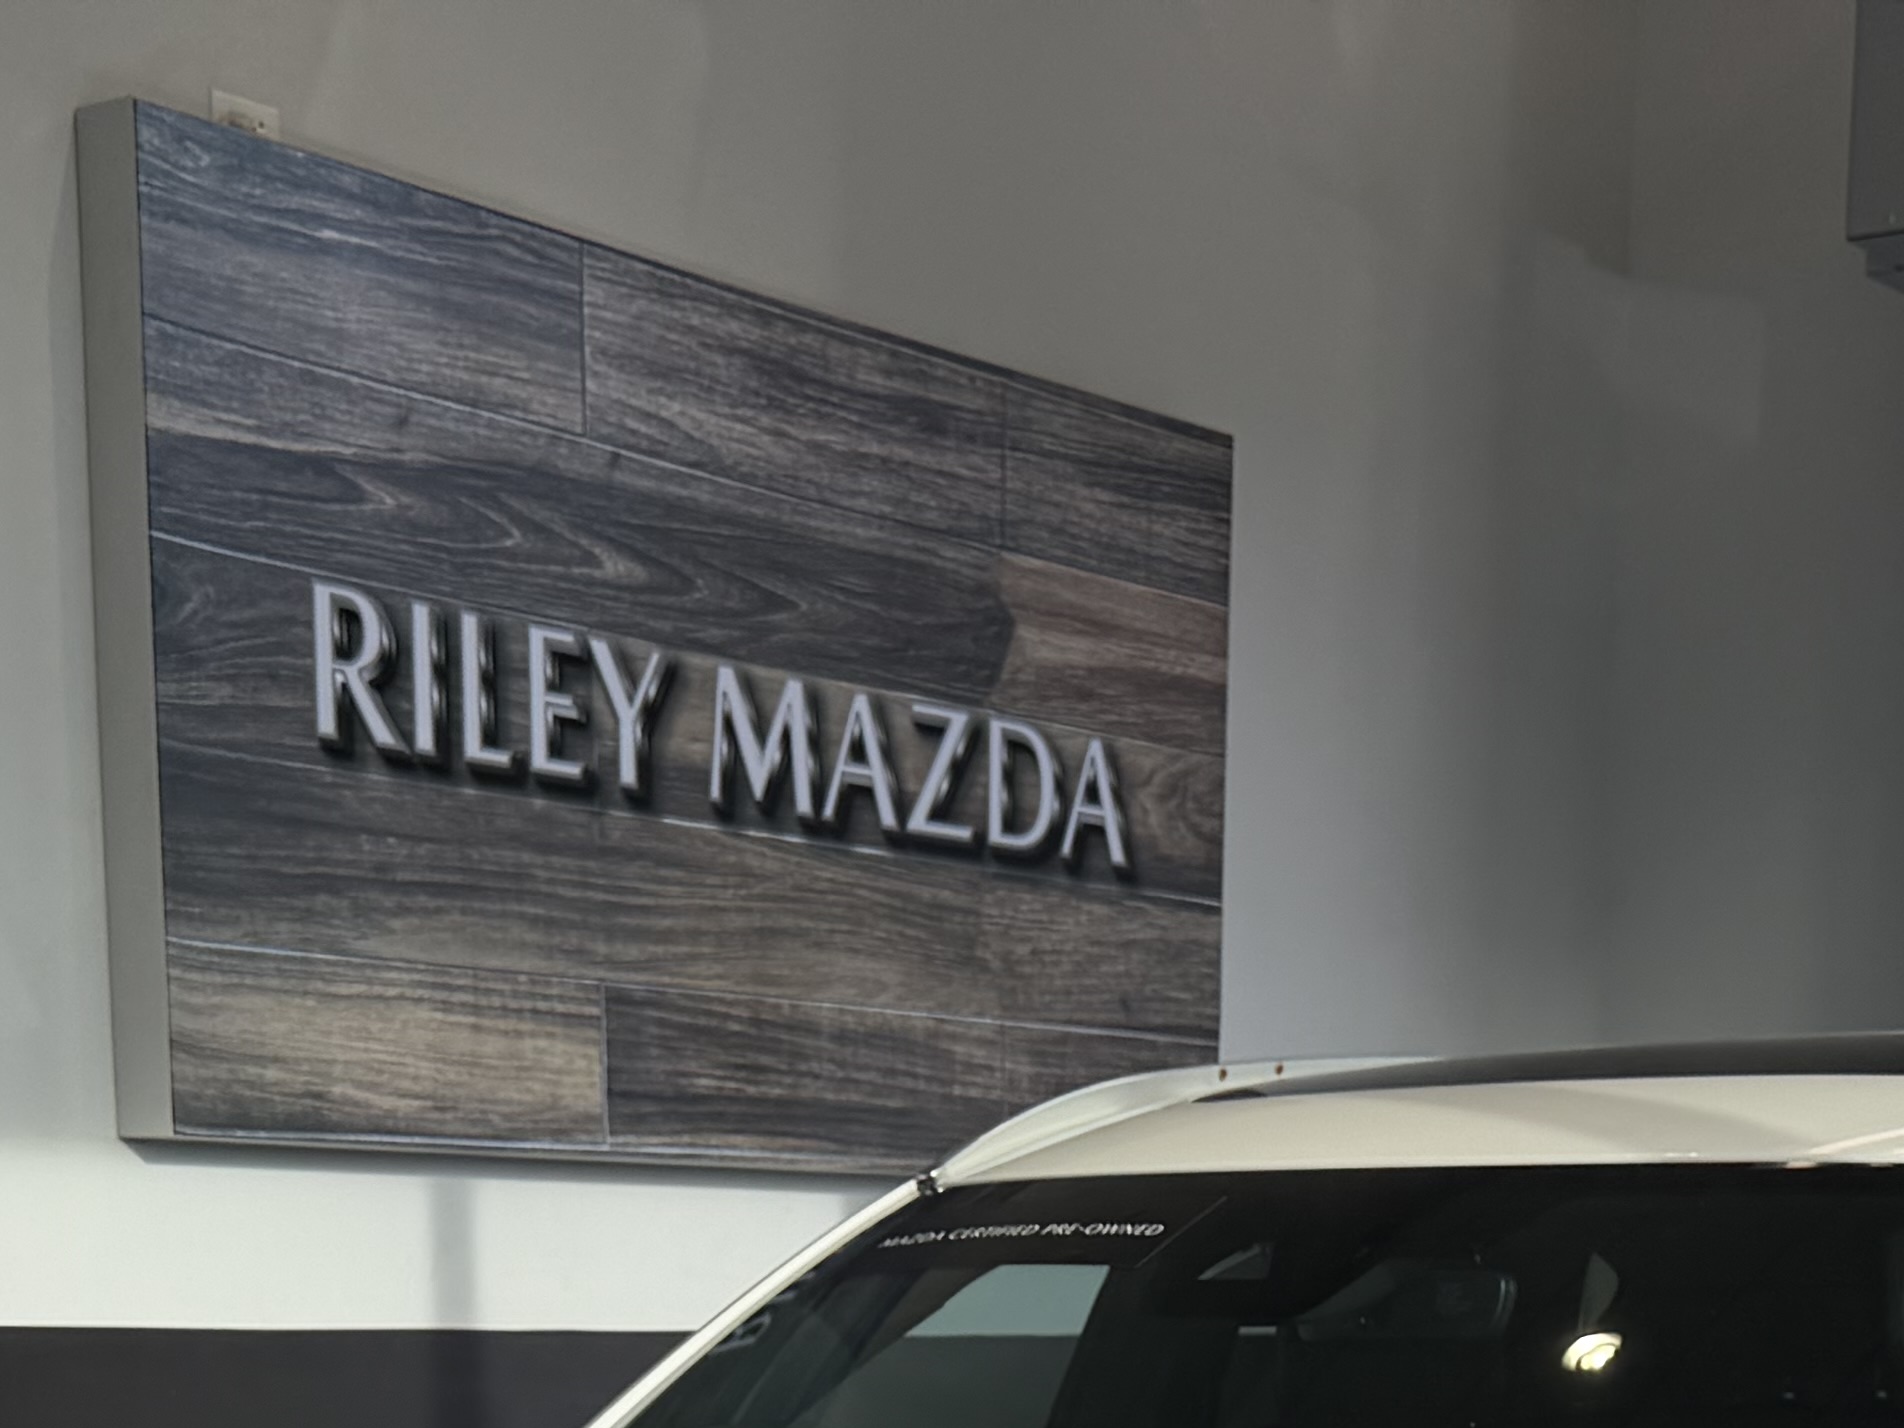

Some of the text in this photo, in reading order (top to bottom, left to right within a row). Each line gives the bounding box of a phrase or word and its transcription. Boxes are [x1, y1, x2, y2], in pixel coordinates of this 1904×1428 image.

[312, 578, 1132, 870] RILEY MAZDA
[877, 1222, 1165, 1249] MAZDA CERTIFIED PRE-OWNED
